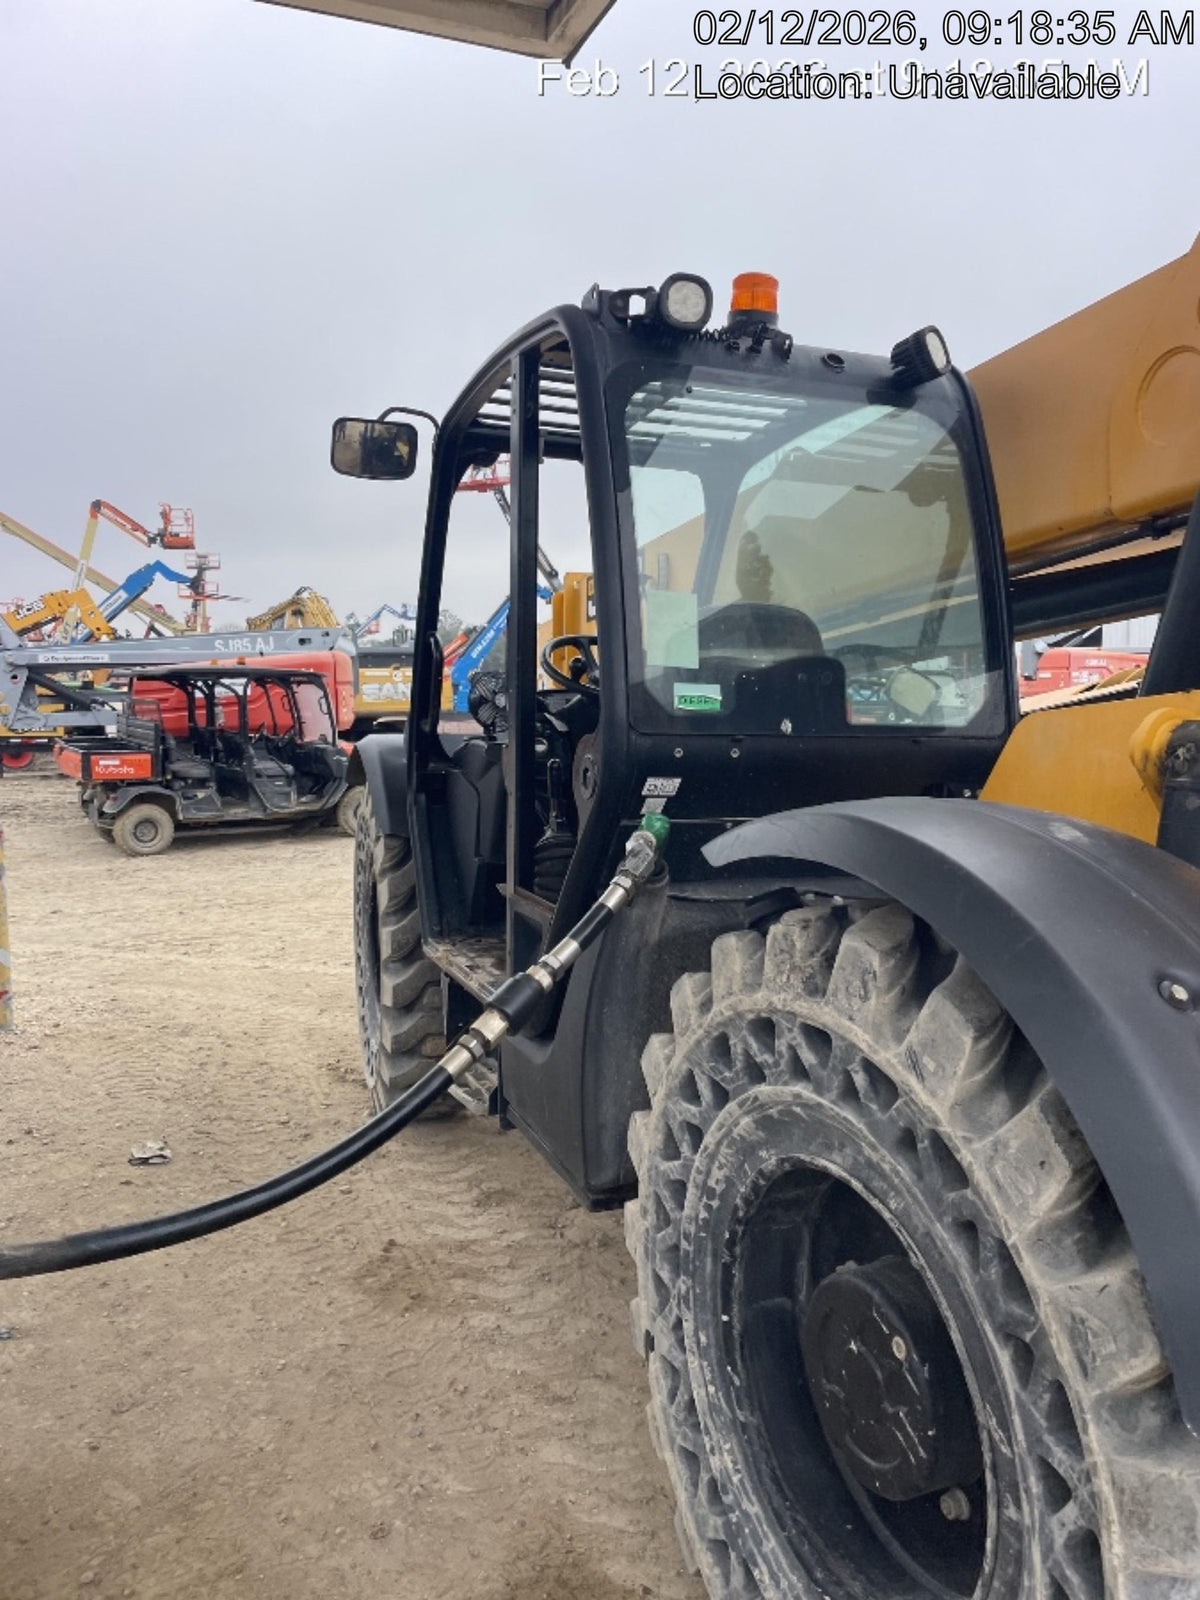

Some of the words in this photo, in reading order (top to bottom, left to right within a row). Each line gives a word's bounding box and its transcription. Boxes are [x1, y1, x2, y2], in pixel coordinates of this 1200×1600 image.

[15, 600, 46, 619] JCB
[254, 635, 275, 652] AJ
[361, 682, 411, 702] SAN
[95, 765, 135, 774] Kubota
